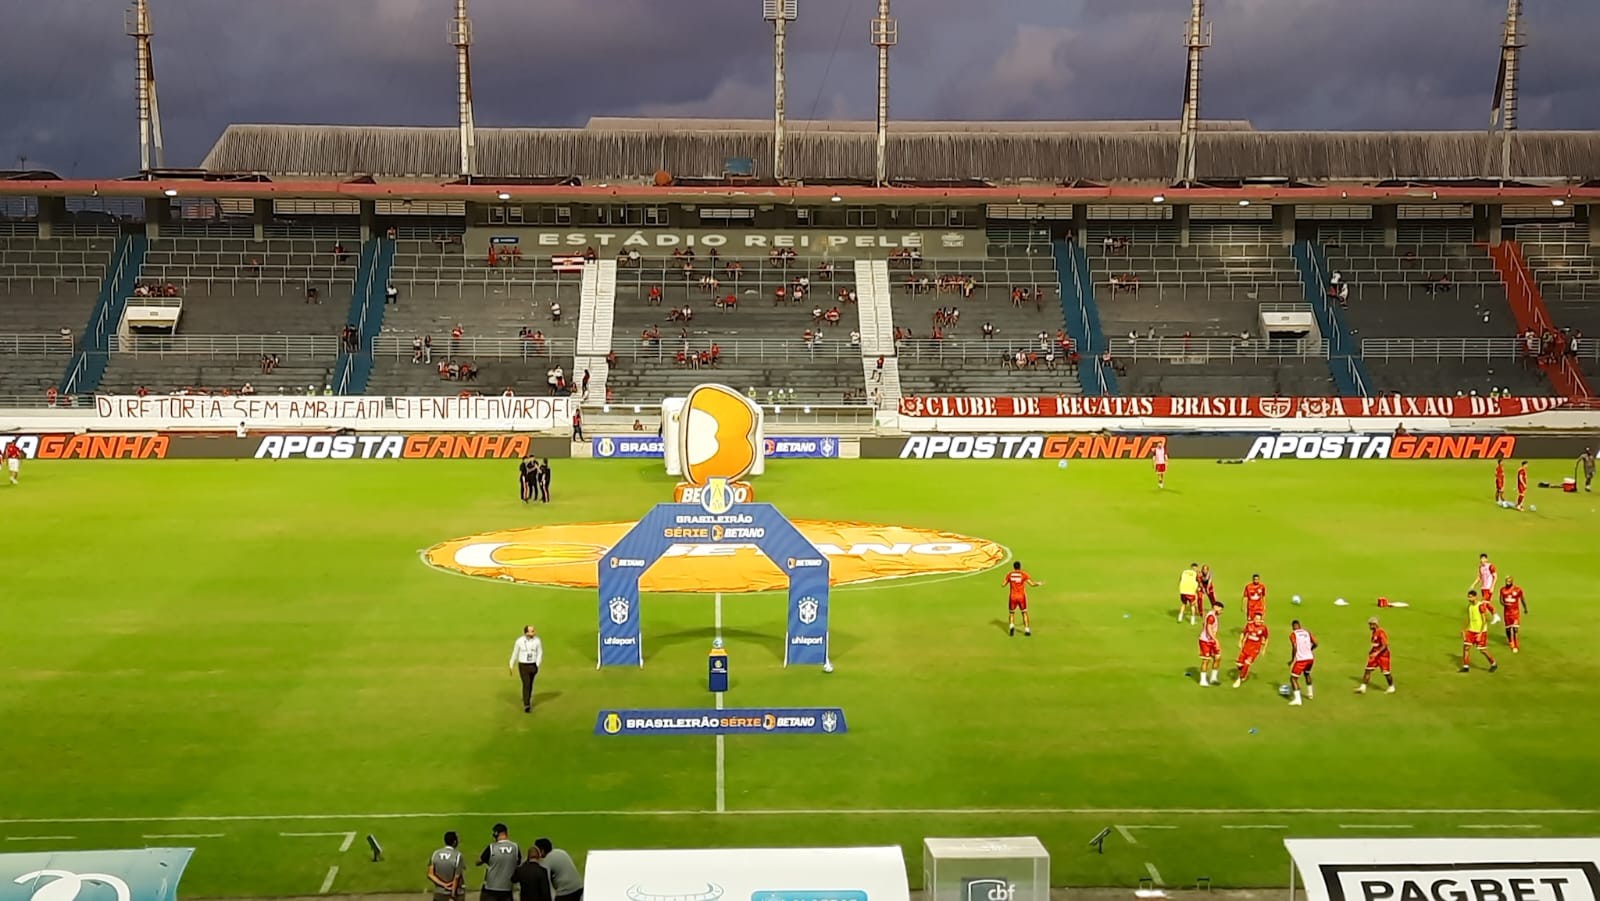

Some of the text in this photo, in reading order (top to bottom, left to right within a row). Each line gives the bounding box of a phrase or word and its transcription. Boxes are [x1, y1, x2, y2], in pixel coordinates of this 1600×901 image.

[538, 231, 922, 247] ESTÁDIO REI PELÉ
[926, 397, 998, 416] CLUBE
[1012, 397, 1040, 416] DE
[1056, 397, 1153, 416] REGATAS
[1170, 397, 1252, 416] BRASIL
[1471, 397, 1501, 415] DE
[38, 435, 170, 459] GANHA
[254, 435, 531, 459] APOSTA GANHA
[775, 442, 816, 453] BETANO
[899, 436, 1167, 459] APOSTA GANHA
[1247, 435, 1516, 459] APOSTA GANHA
[676, 514, 753, 524] BRASILEIRÃO
[663, 526, 765, 538] SÉRIE BETANO
[603, 636, 636, 646] uhlsport
[791, 636, 824, 646] uhlsport
[626, 713, 816, 728] BRASILEIRÃO SÉRIE BETANO
[440, 852, 452, 860] TV
[500, 846, 513, 854] TV
[987, 884, 1016, 901] cbf
[1360, 877, 1569, 901] PAGBET
